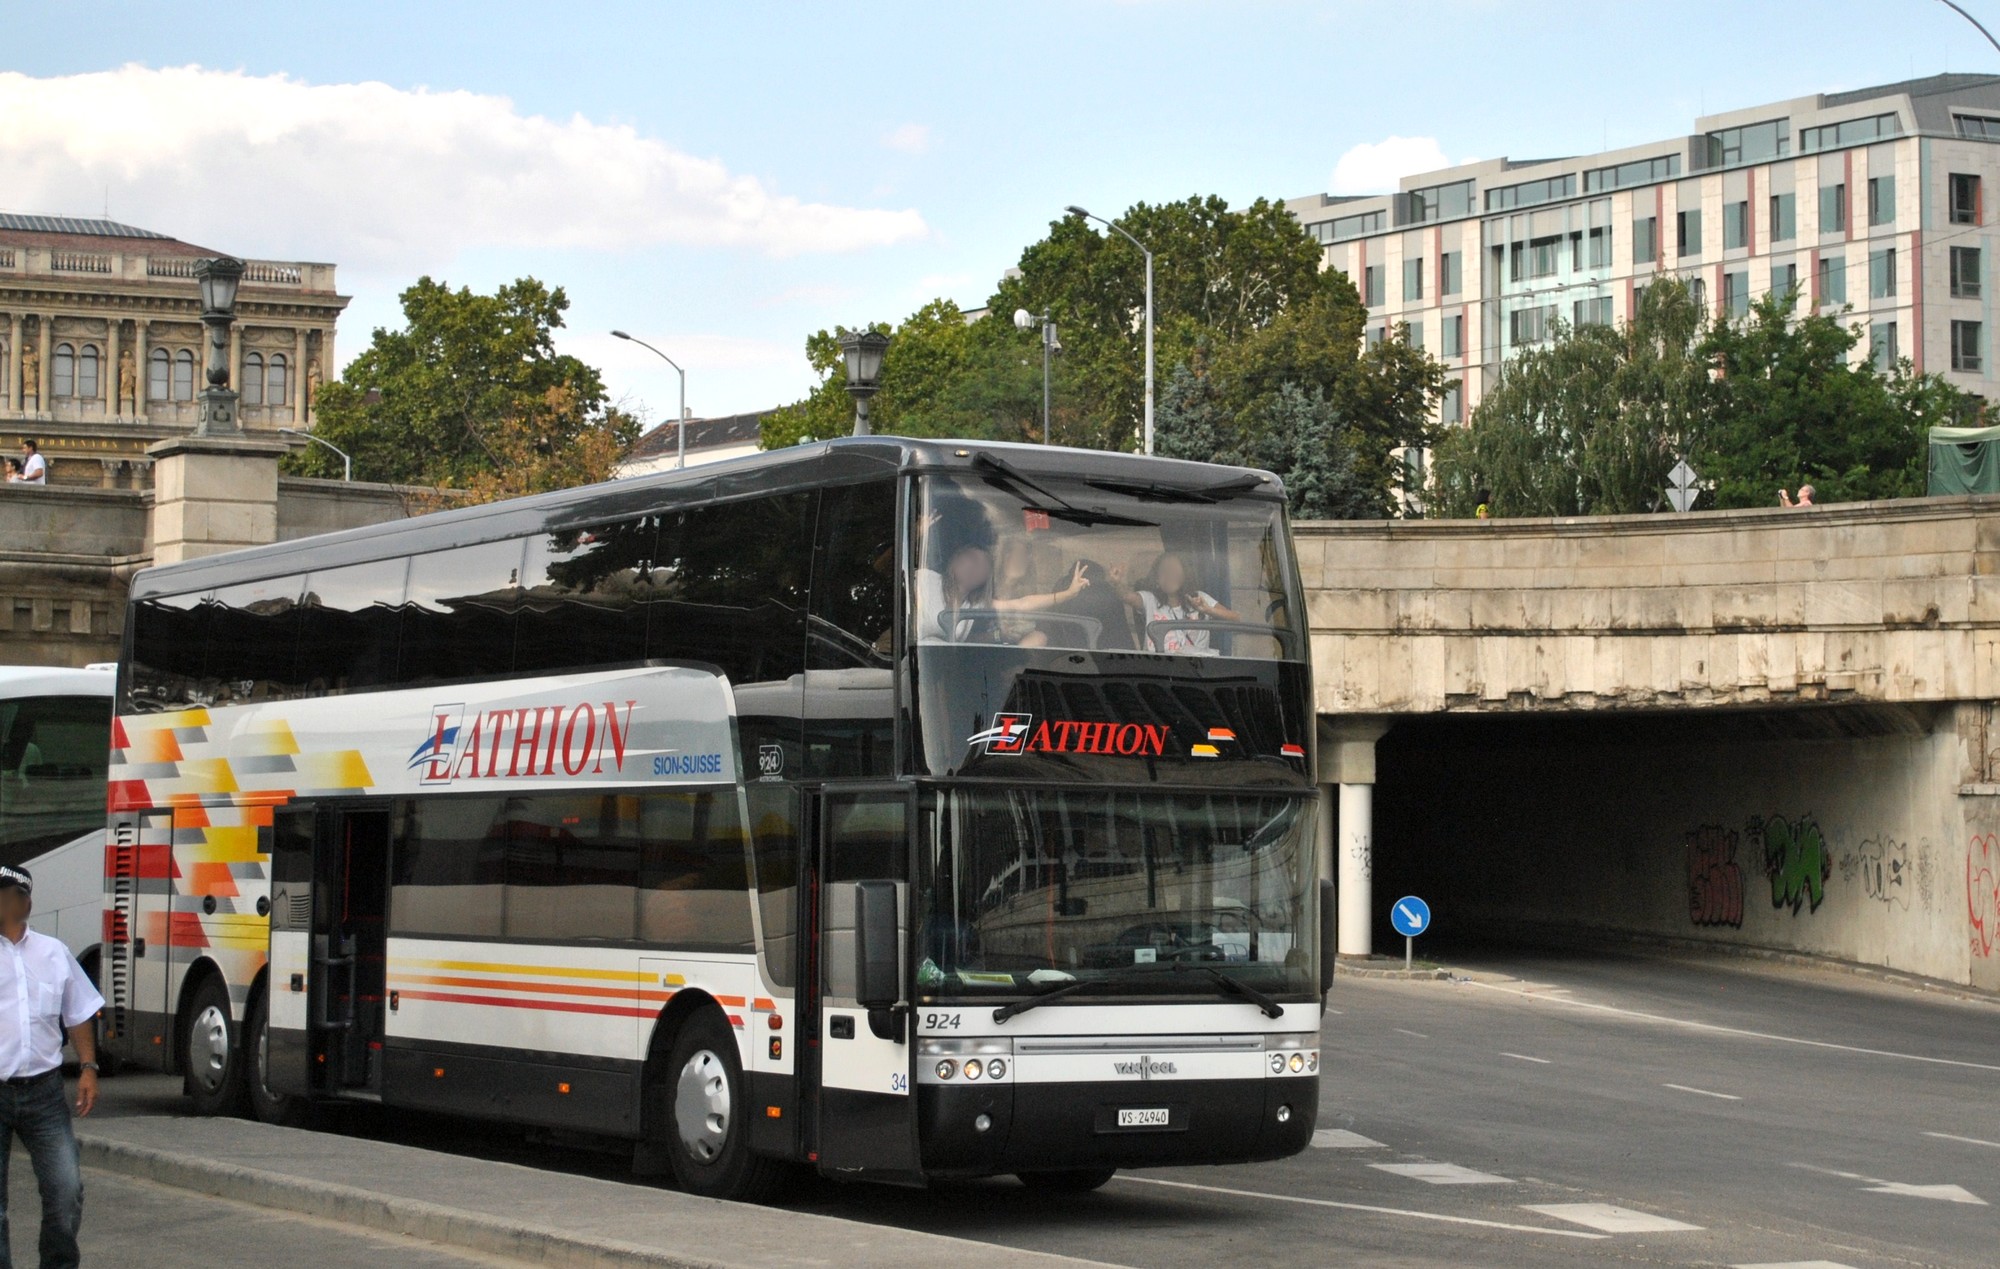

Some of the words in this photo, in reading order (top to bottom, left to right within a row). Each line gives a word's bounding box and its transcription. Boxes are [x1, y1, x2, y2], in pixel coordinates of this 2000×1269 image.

[425, 700, 636, 780] LATHION
[993, 717, 1170, 756] LATHION
[654, 755, 721, 775] SION-SUISSE
[926, 1013, 961, 1029] 924
[892, 1073, 907, 1091] 34
